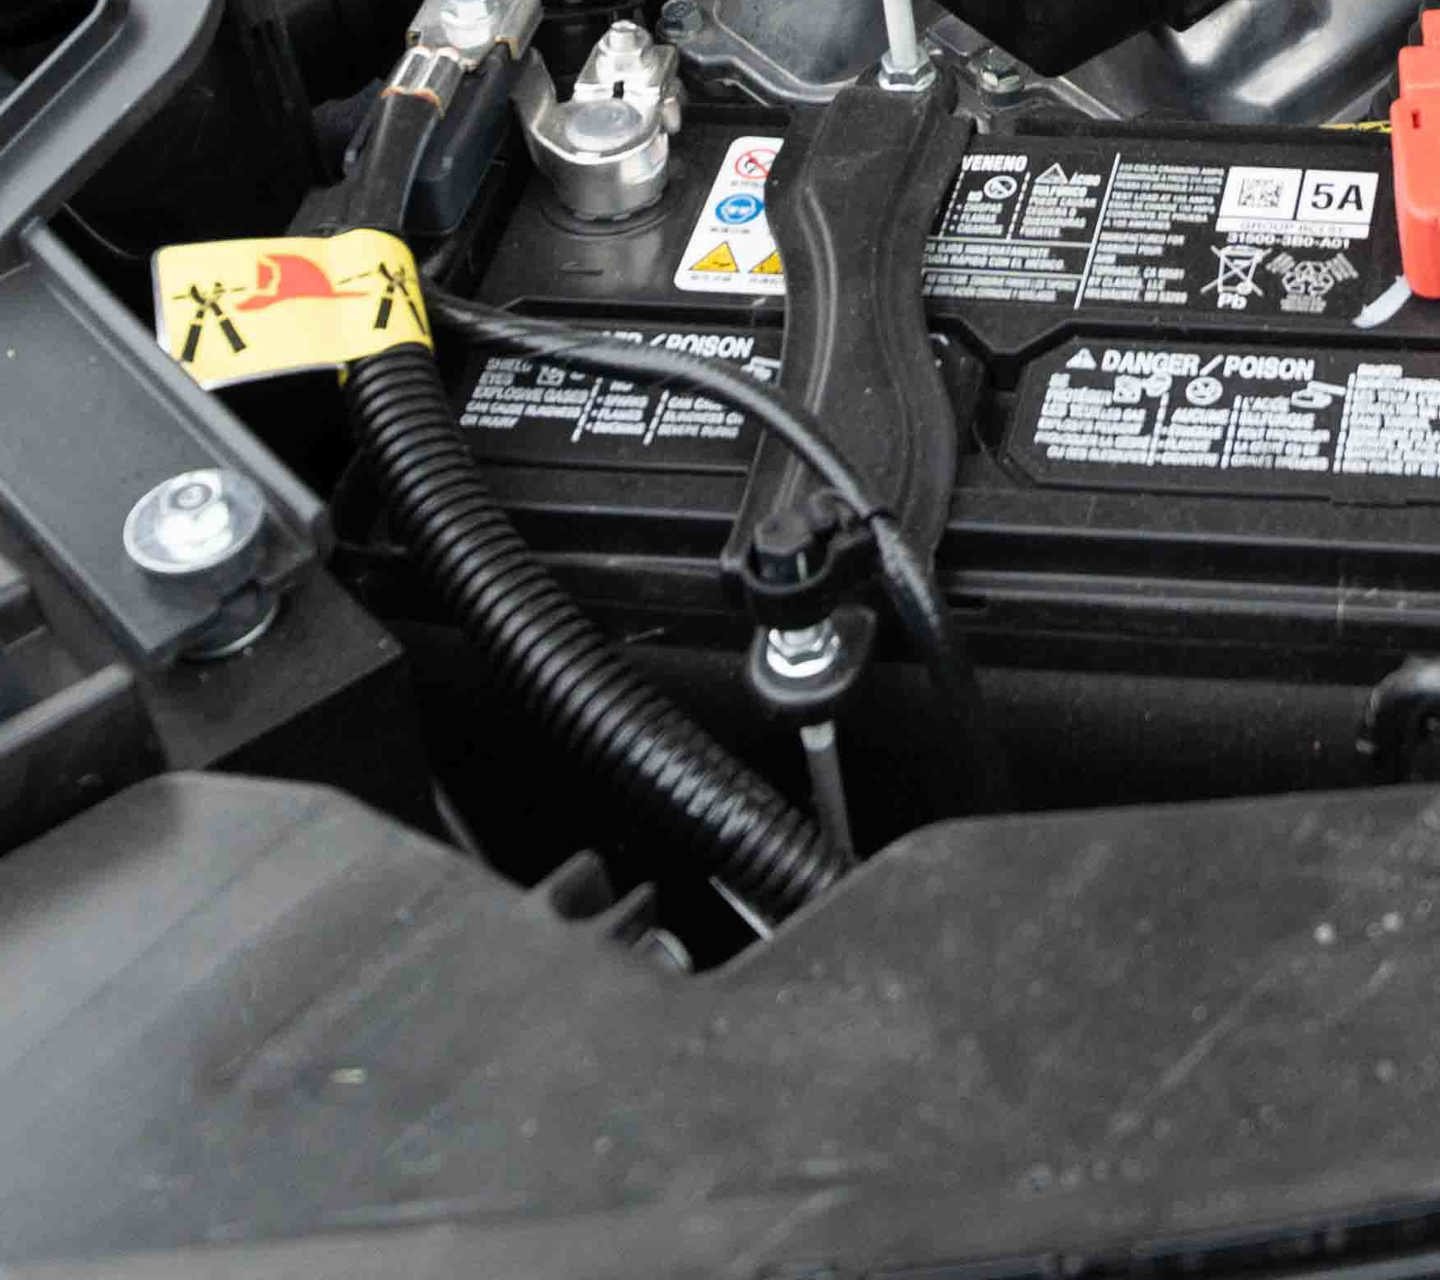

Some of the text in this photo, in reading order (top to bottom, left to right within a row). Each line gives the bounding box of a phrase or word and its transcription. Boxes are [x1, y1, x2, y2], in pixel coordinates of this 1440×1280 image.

[961, 154, 1028, 172] VENENO
[1311, 183, 1364, 211] 5A
[1217, 293, 1248, 310] Pb
[1101, 349, 1201, 375] DANGER
[1223, 355, 1315, 380] POISON
